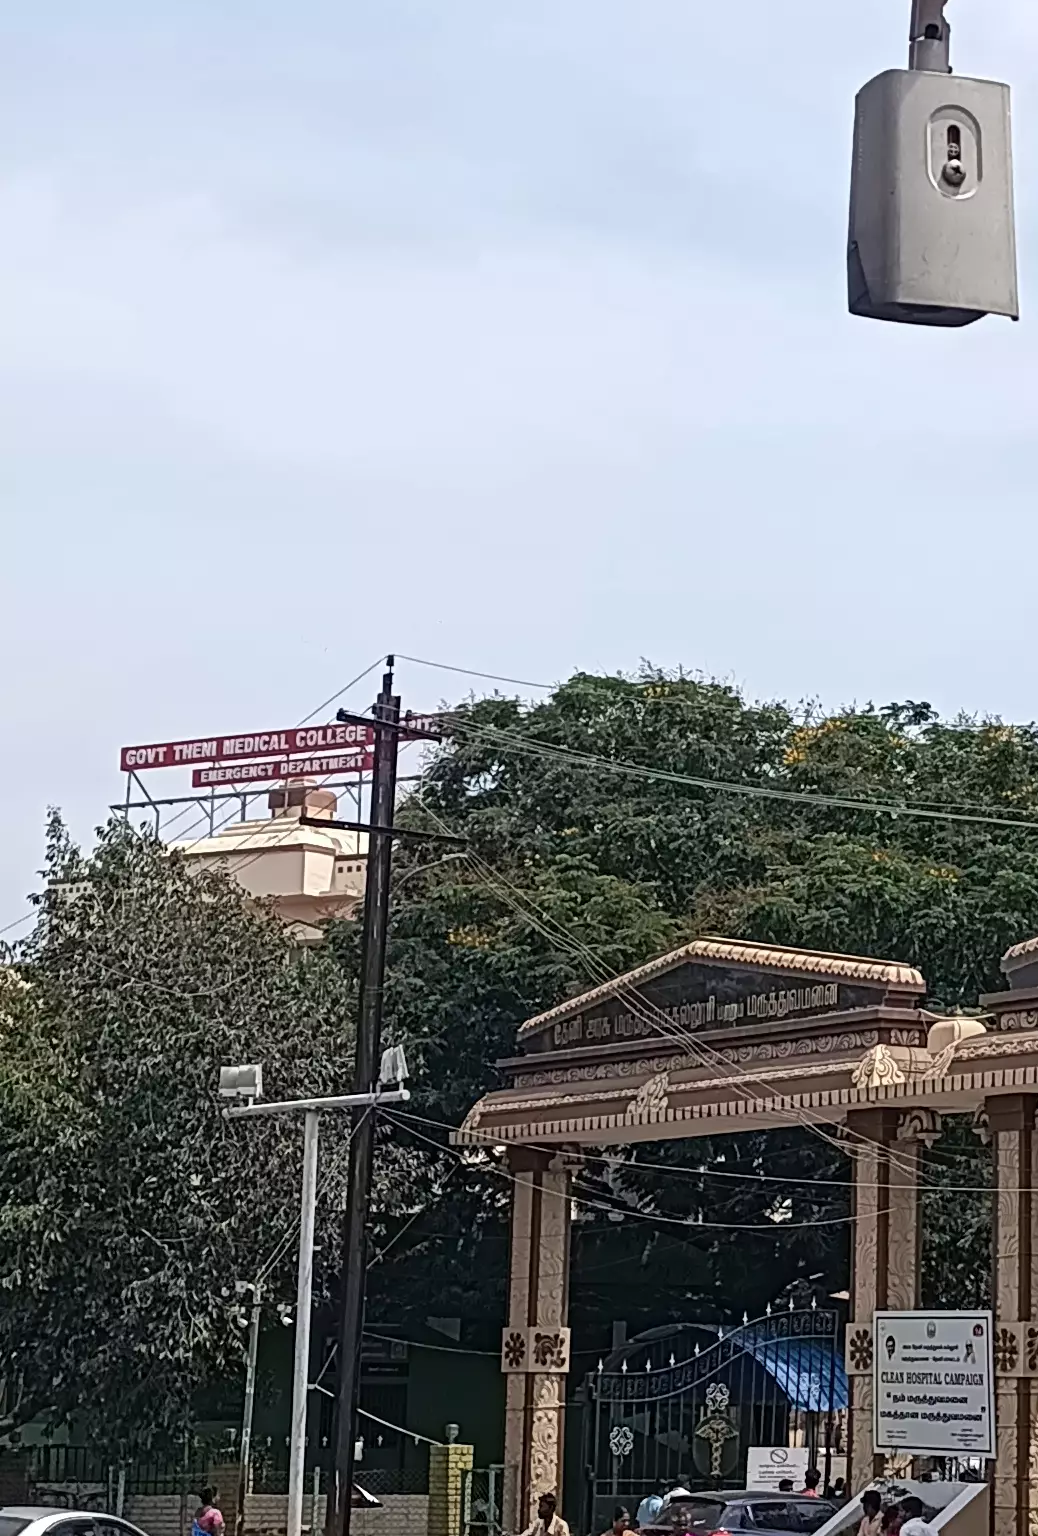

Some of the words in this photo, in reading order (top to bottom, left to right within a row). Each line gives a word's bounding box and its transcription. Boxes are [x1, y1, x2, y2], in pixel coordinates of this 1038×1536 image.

[125, 747, 167, 765] GOVT
[173, 740, 217, 760] THENI
[222, 733, 289, 756] MEDICAL
[296, 725, 367, 747] COLLEGE
[200, 764, 274, 783] EMERGENCY
[280, 754, 365, 775] DEPARTMENT
[747, 983, 839, 1018] மருத்துவமனை
[881, 1372, 904, 1384] CLEAN
[906, 1373, 942, 1385] HOSPITAL
[944, 1373, 984, 1386] CAMPAIGN
